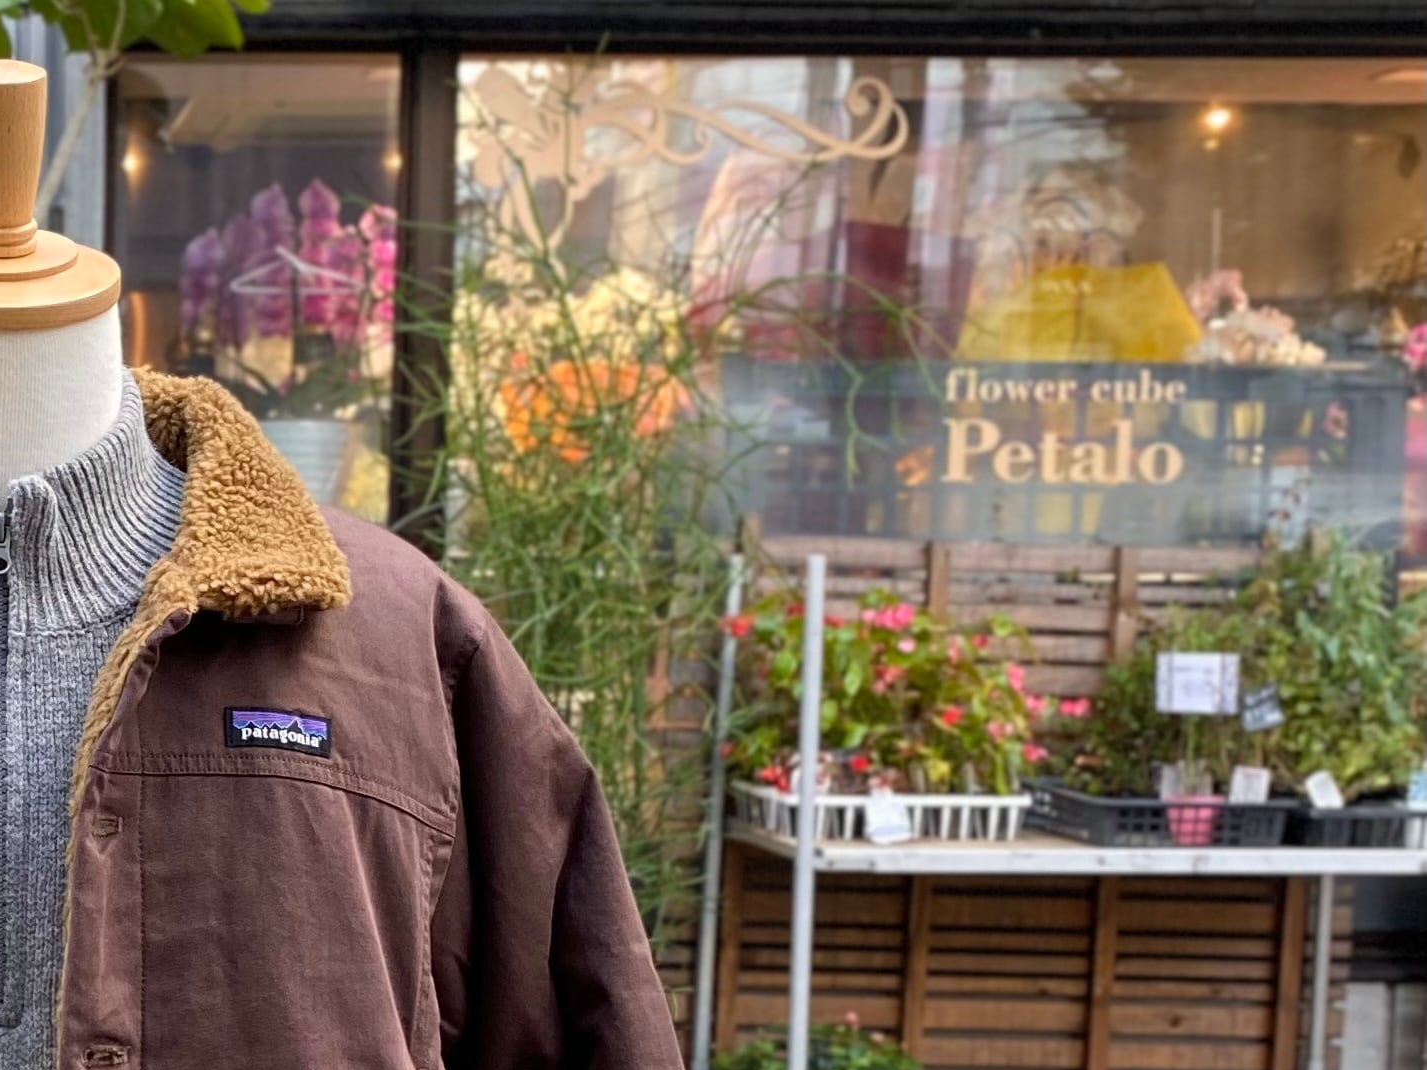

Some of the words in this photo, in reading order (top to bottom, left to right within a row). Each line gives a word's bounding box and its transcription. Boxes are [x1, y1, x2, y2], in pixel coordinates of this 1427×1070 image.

[945, 366, 1079, 403] flower
[1090, 368, 1188, 404] cube
[940, 416, 1184, 485] Petalo
[241, 727, 320, 748] patagonia
